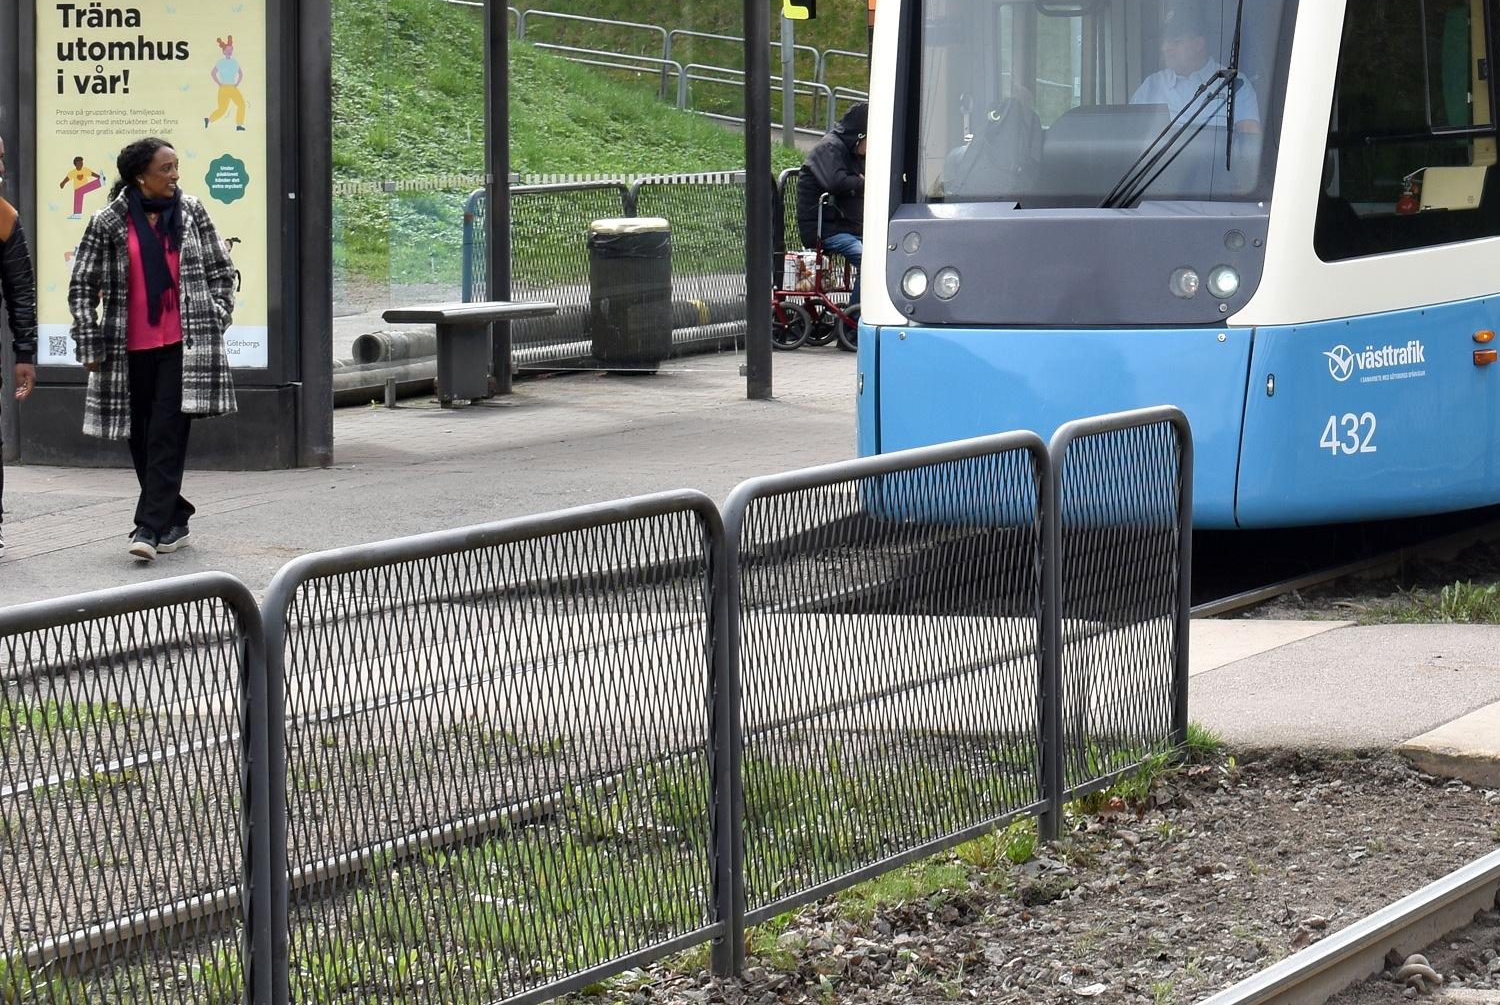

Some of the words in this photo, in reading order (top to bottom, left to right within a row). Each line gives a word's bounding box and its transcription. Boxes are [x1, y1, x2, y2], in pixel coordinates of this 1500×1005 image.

[56, 2, 141, 28] Träna
[57, 35, 189, 61] utomhus
[57, 68, 64, 95] i
[73, 64, 130, 95] vår!
[75, 108, 84, 117] på
[69, 119, 94, 127] utegym
[96, 128, 114, 136] gratis
[226, 339, 261, 349] Göteborgs
[226, 347, 241, 355] Stad
[1356, 340, 1425, 370] västtrafik
[1319, 411, 1377, 456] 432
